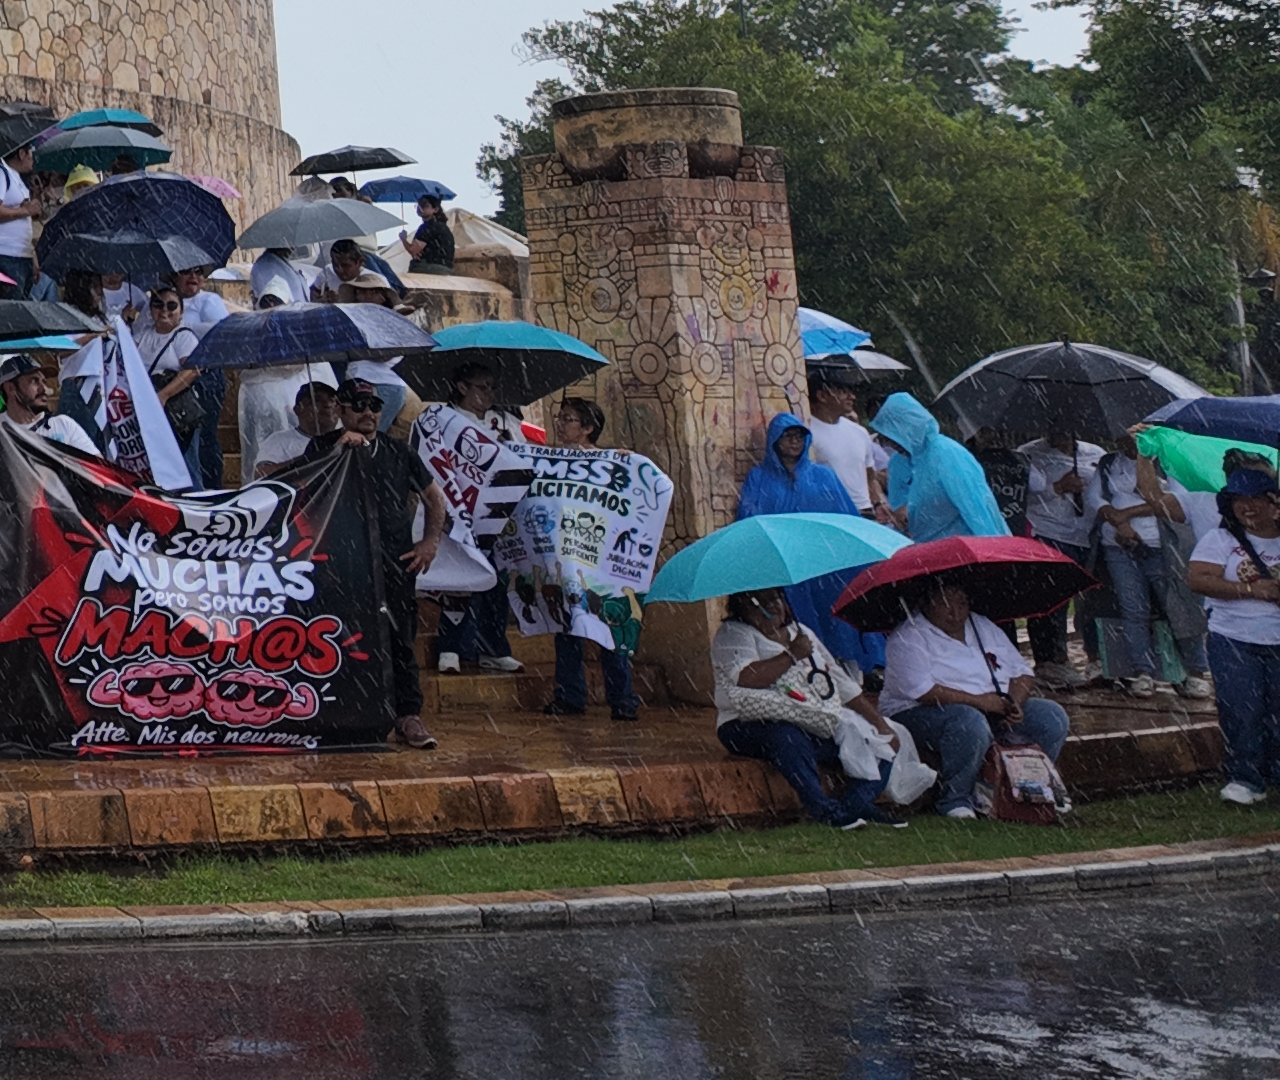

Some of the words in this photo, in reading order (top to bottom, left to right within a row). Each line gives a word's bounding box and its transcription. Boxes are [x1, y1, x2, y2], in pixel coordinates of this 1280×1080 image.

[530, 446, 610, 459] TRABAJADORES
[613, 454, 632, 466] DEL
[106, 522, 157, 556] No
[83, 549, 315, 602] MUCHAS
[612, 564, 643, 580] DIGNA
[134, 589, 189, 615] pero
[198, 593, 287, 615] somos
[57, 600, 341, 676] MACH@S
[137, 724, 176, 746] Mis
[179, 724, 218, 745] dos
[223, 728, 323, 750] neuronas
